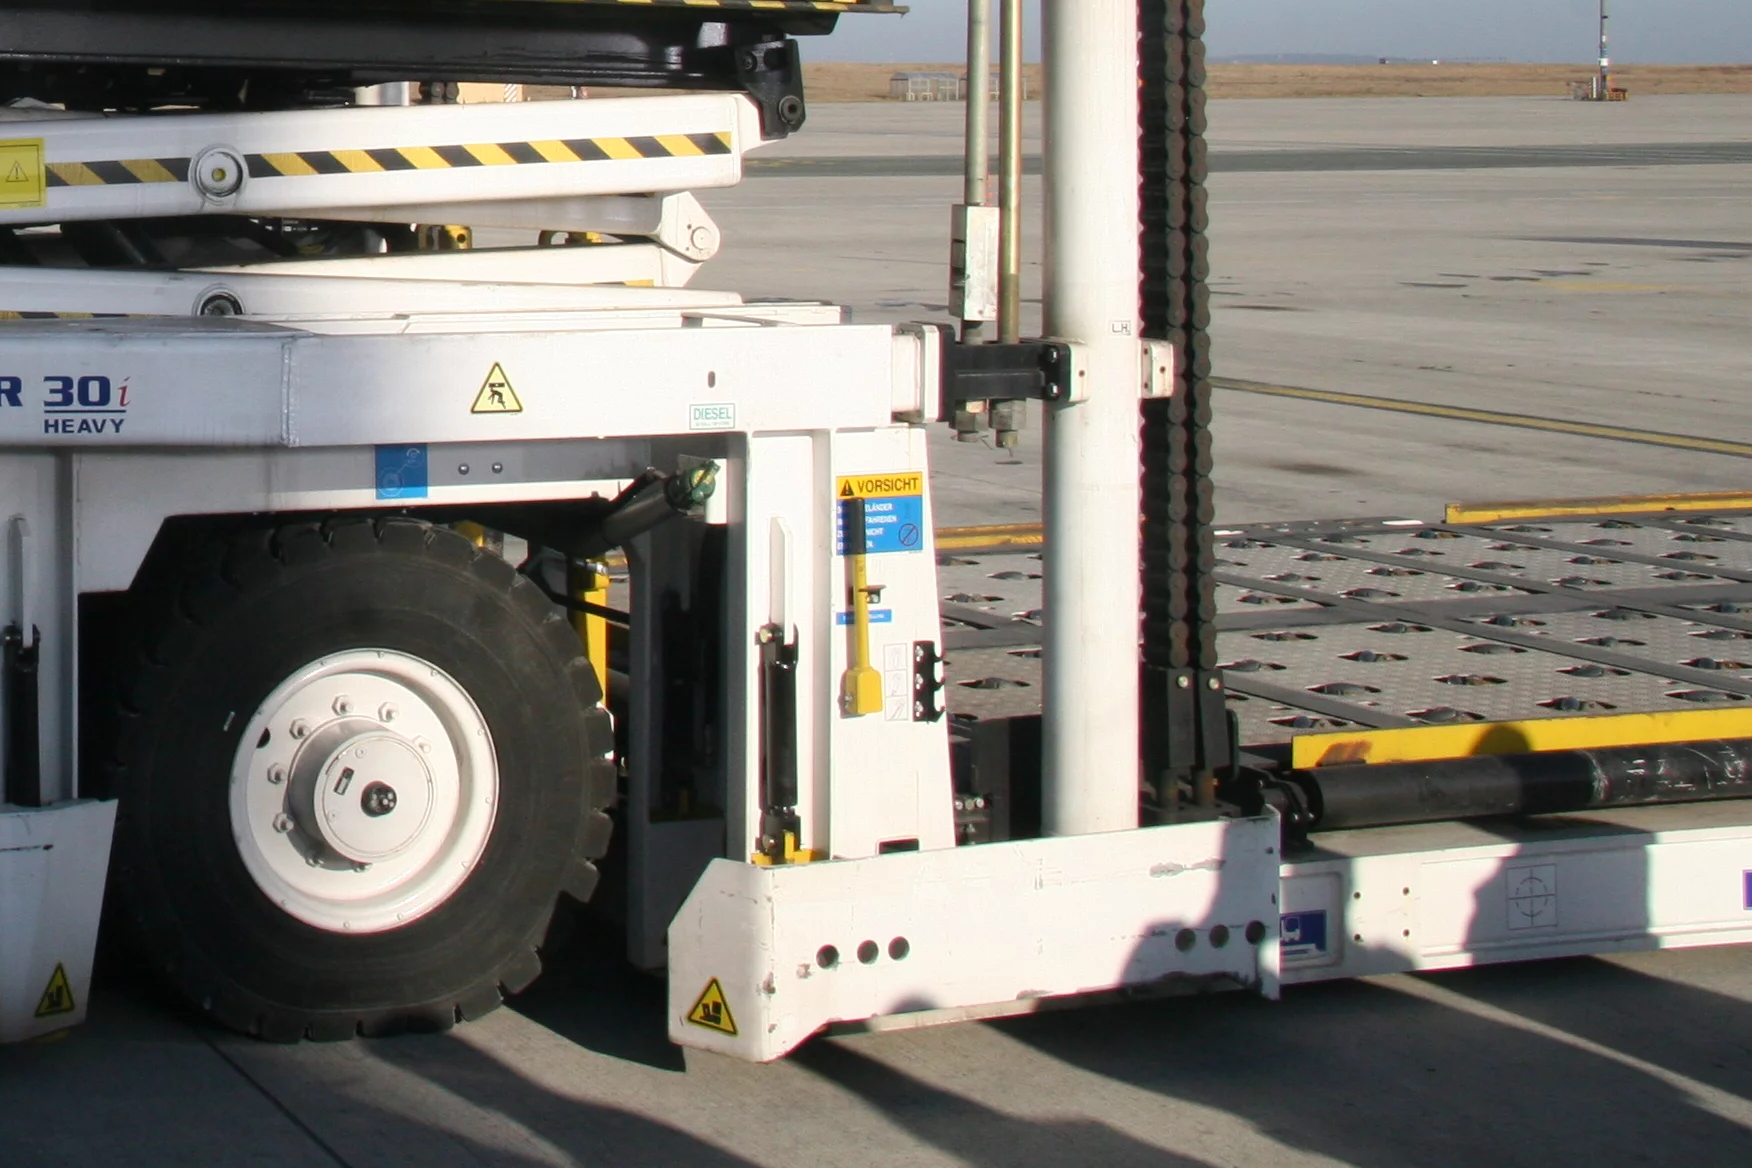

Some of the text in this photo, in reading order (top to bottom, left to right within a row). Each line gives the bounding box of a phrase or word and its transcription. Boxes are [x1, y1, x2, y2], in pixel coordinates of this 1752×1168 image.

[693, 407, 732, 420] DIESEL
[43, 418, 125, 434] HEAVY
[857, 477, 919, 493] VORSICHT
